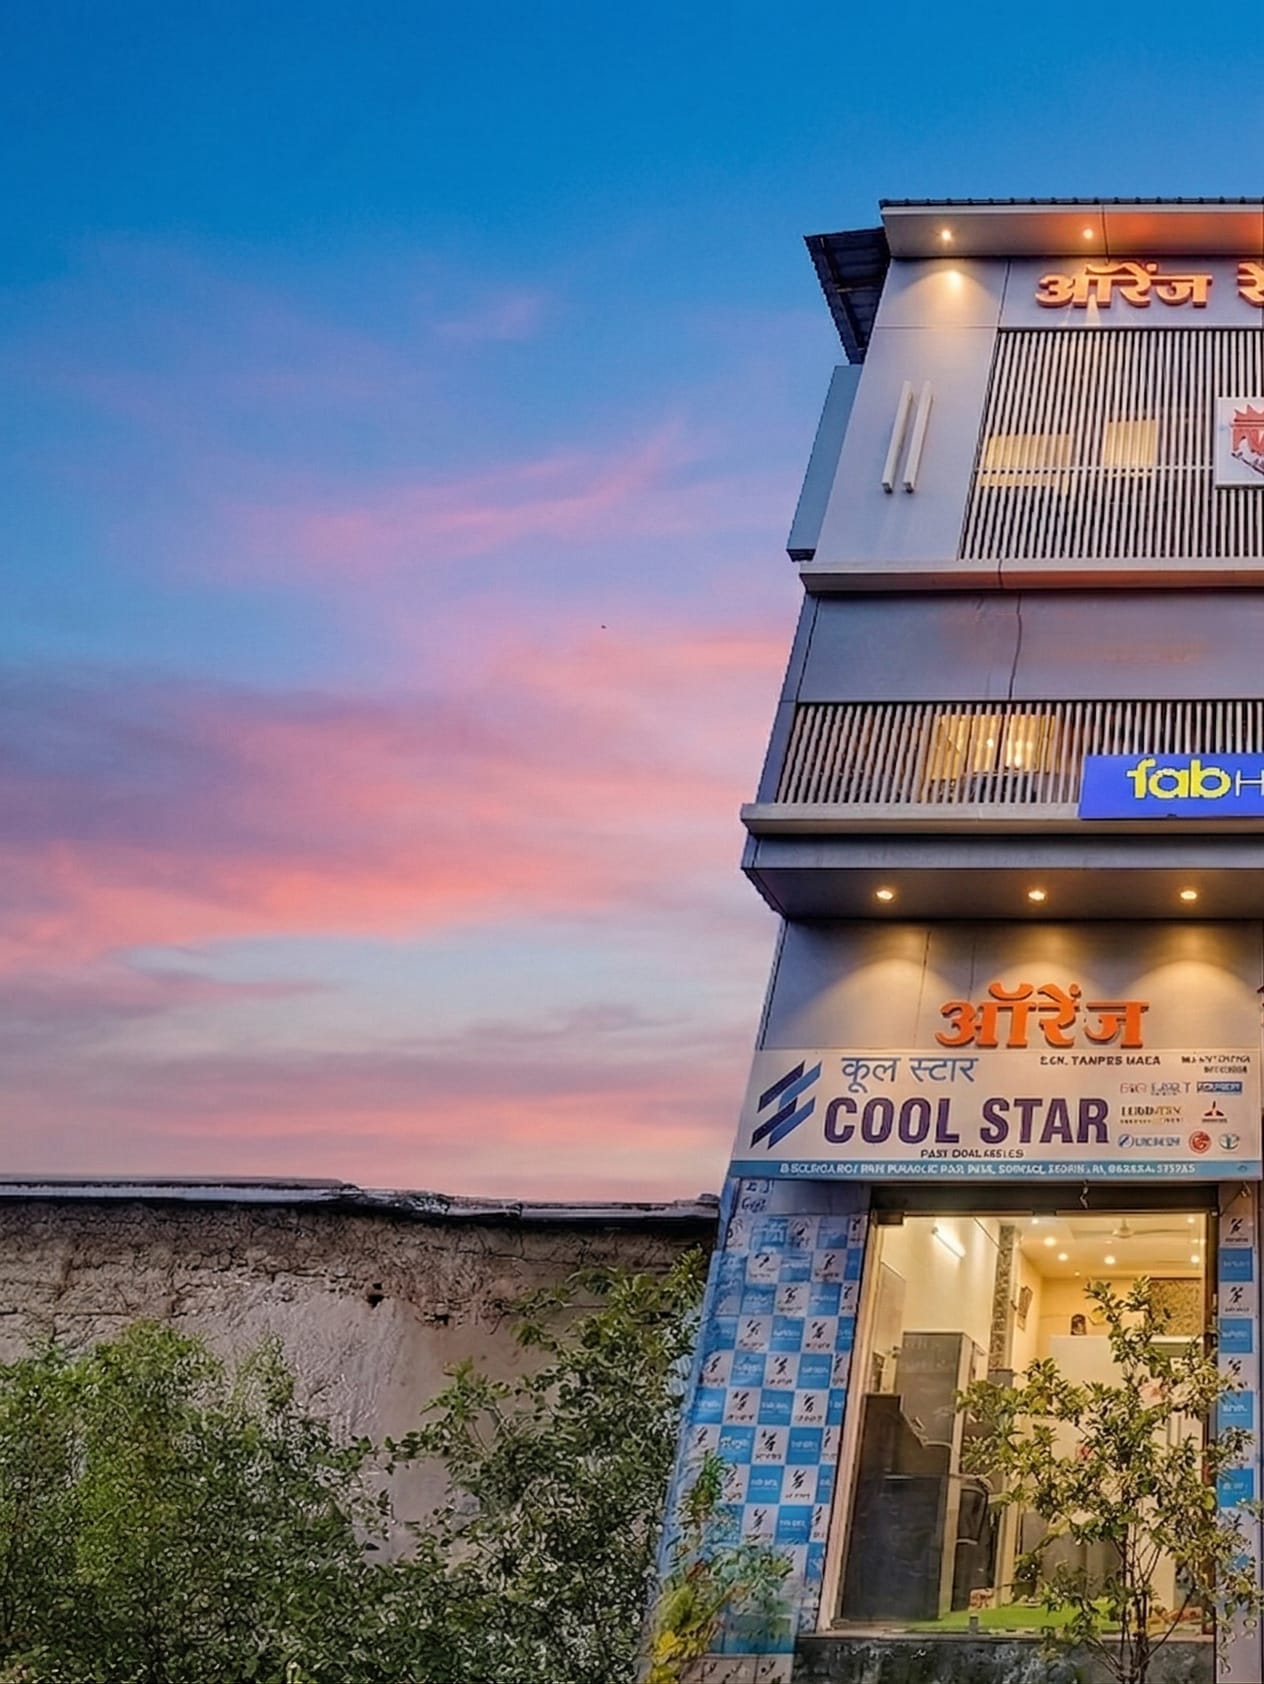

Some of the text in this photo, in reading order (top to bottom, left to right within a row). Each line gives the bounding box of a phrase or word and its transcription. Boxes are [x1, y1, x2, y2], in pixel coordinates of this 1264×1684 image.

[935, 981, 1149, 1050] ऑरेंज
[841, 1057, 979, 1093] कूल स्टार
[823, 1097, 1110, 1145] COOL STAR
